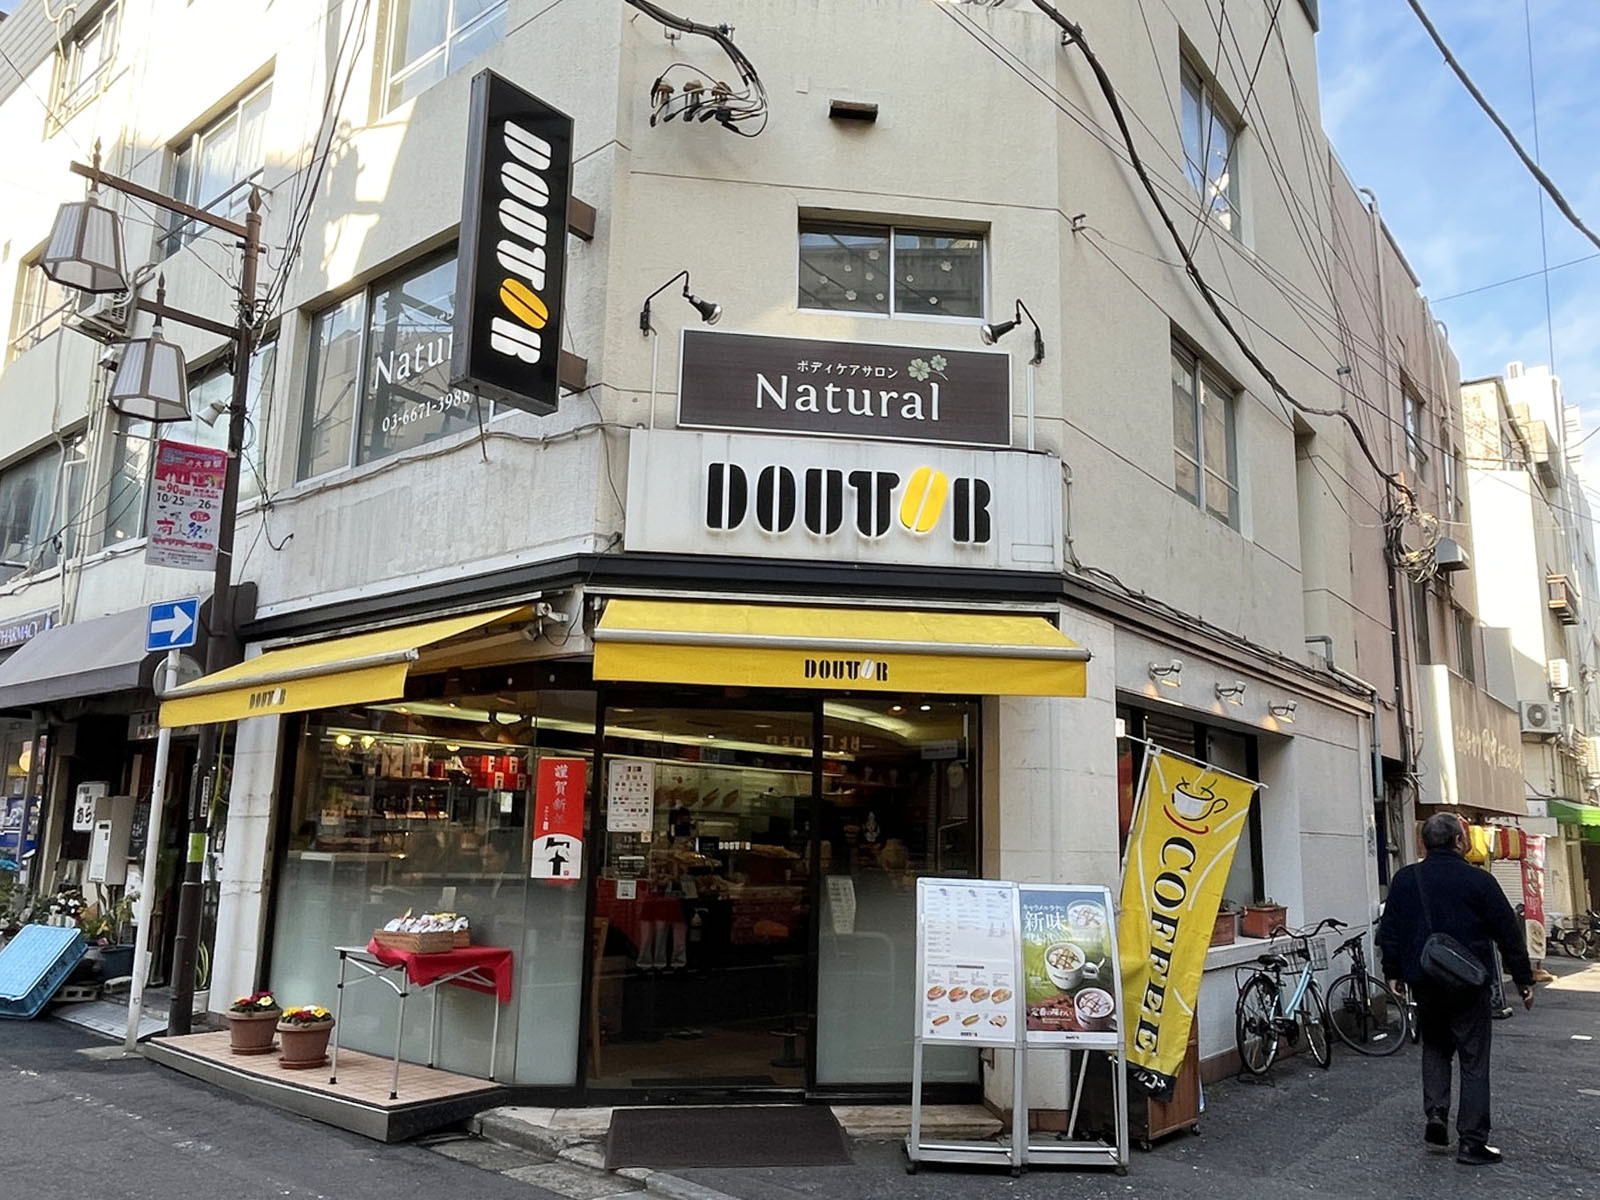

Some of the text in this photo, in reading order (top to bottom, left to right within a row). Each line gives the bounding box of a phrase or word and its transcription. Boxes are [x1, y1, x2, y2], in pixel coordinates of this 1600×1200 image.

[491, 120, 552, 364] DOUTOR
[797, 360, 899, 380] ボディケアサロン
[756, 373, 940, 421] Natural
[706, 462, 991, 544] DOUTOR
[804, 659, 888, 681] DOUTOR
[1025, 911, 1070, 932] 新味
[1135, 836, 1196, 1057] COFFEE
